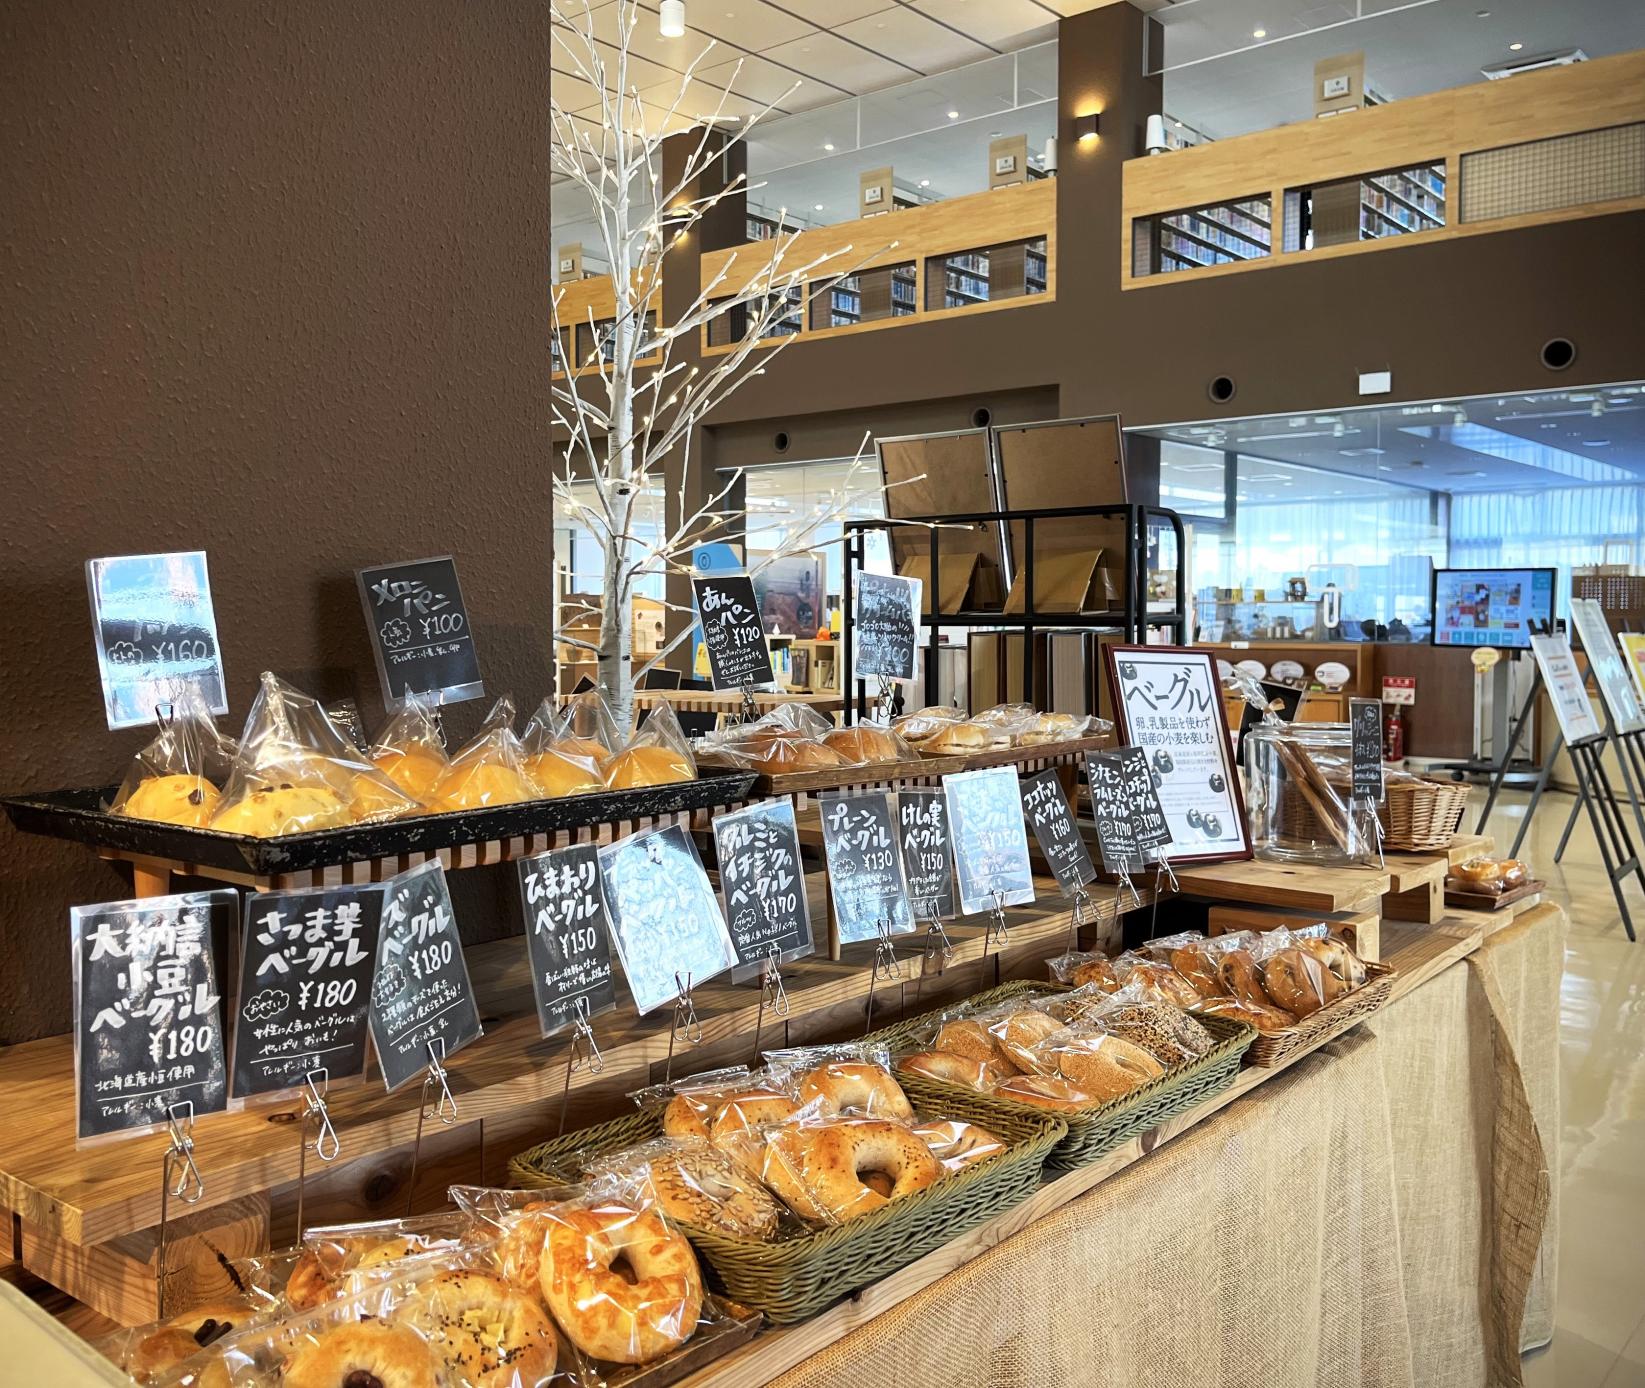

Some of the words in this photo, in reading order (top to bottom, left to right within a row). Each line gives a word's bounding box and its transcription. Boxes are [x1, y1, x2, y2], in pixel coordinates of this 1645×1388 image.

[370, 579, 428, 607] メロン
[403, 590, 451, 618] パン
[702, 586, 734, 612] あん
[419, 612, 464, 640] ¥100
[720, 604, 755, 626] パン
[732, 626, 760, 648] ¥120
[1127, 666, 1212, 714] ベーグル
[1135, 715, 1211, 732] 卵、乳製品を使わず
[1138, 732, 1214, 746] 国産の小麦を楽しむ
[1024, 780, 1058, 811] ココナッツ
[828, 802, 877, 831] プレーン
[901, 799, 943, 828] けしの実
[1034, 797, 1066, 827] ベーグル
[1097, 802, 1130, 819] ベーグル
[1141, 813, 1162, 831] ¥170
[835, 824, 891, 853] ベーグル
[904, 826, 946, 850] ベーグル
[1050, 817, 1071, 841] ¥160
[1114, 819, 1132, 837] ¥170
[862, 849, 893, 871] ¥130
[920, 853, 944, 872] ¥150
[524, 860, 596, 905] ひまわり
[730, 869, 795, 906] ベーグル
[534, 890, 600, 935] ベーグル
[762, 892, 797, 922] ¥170
[256, 902, 364, 946] さつま芋
[381, 895, 451, 967] ベーグル
[255, 937, 370, 976] ベーグル
[559, 926, 597, 959] ¥150
[408, 940, 452, 980] ¥180
[117, 959, 190, 997] 小豆
[89, 983, 222, 1033] ベーグル
[298, 978, 358, 1011] ¥180
[148, 1025, 212, 1064] ¥180
[94, 1064, 196, 1093] 北海道産小豆使用
